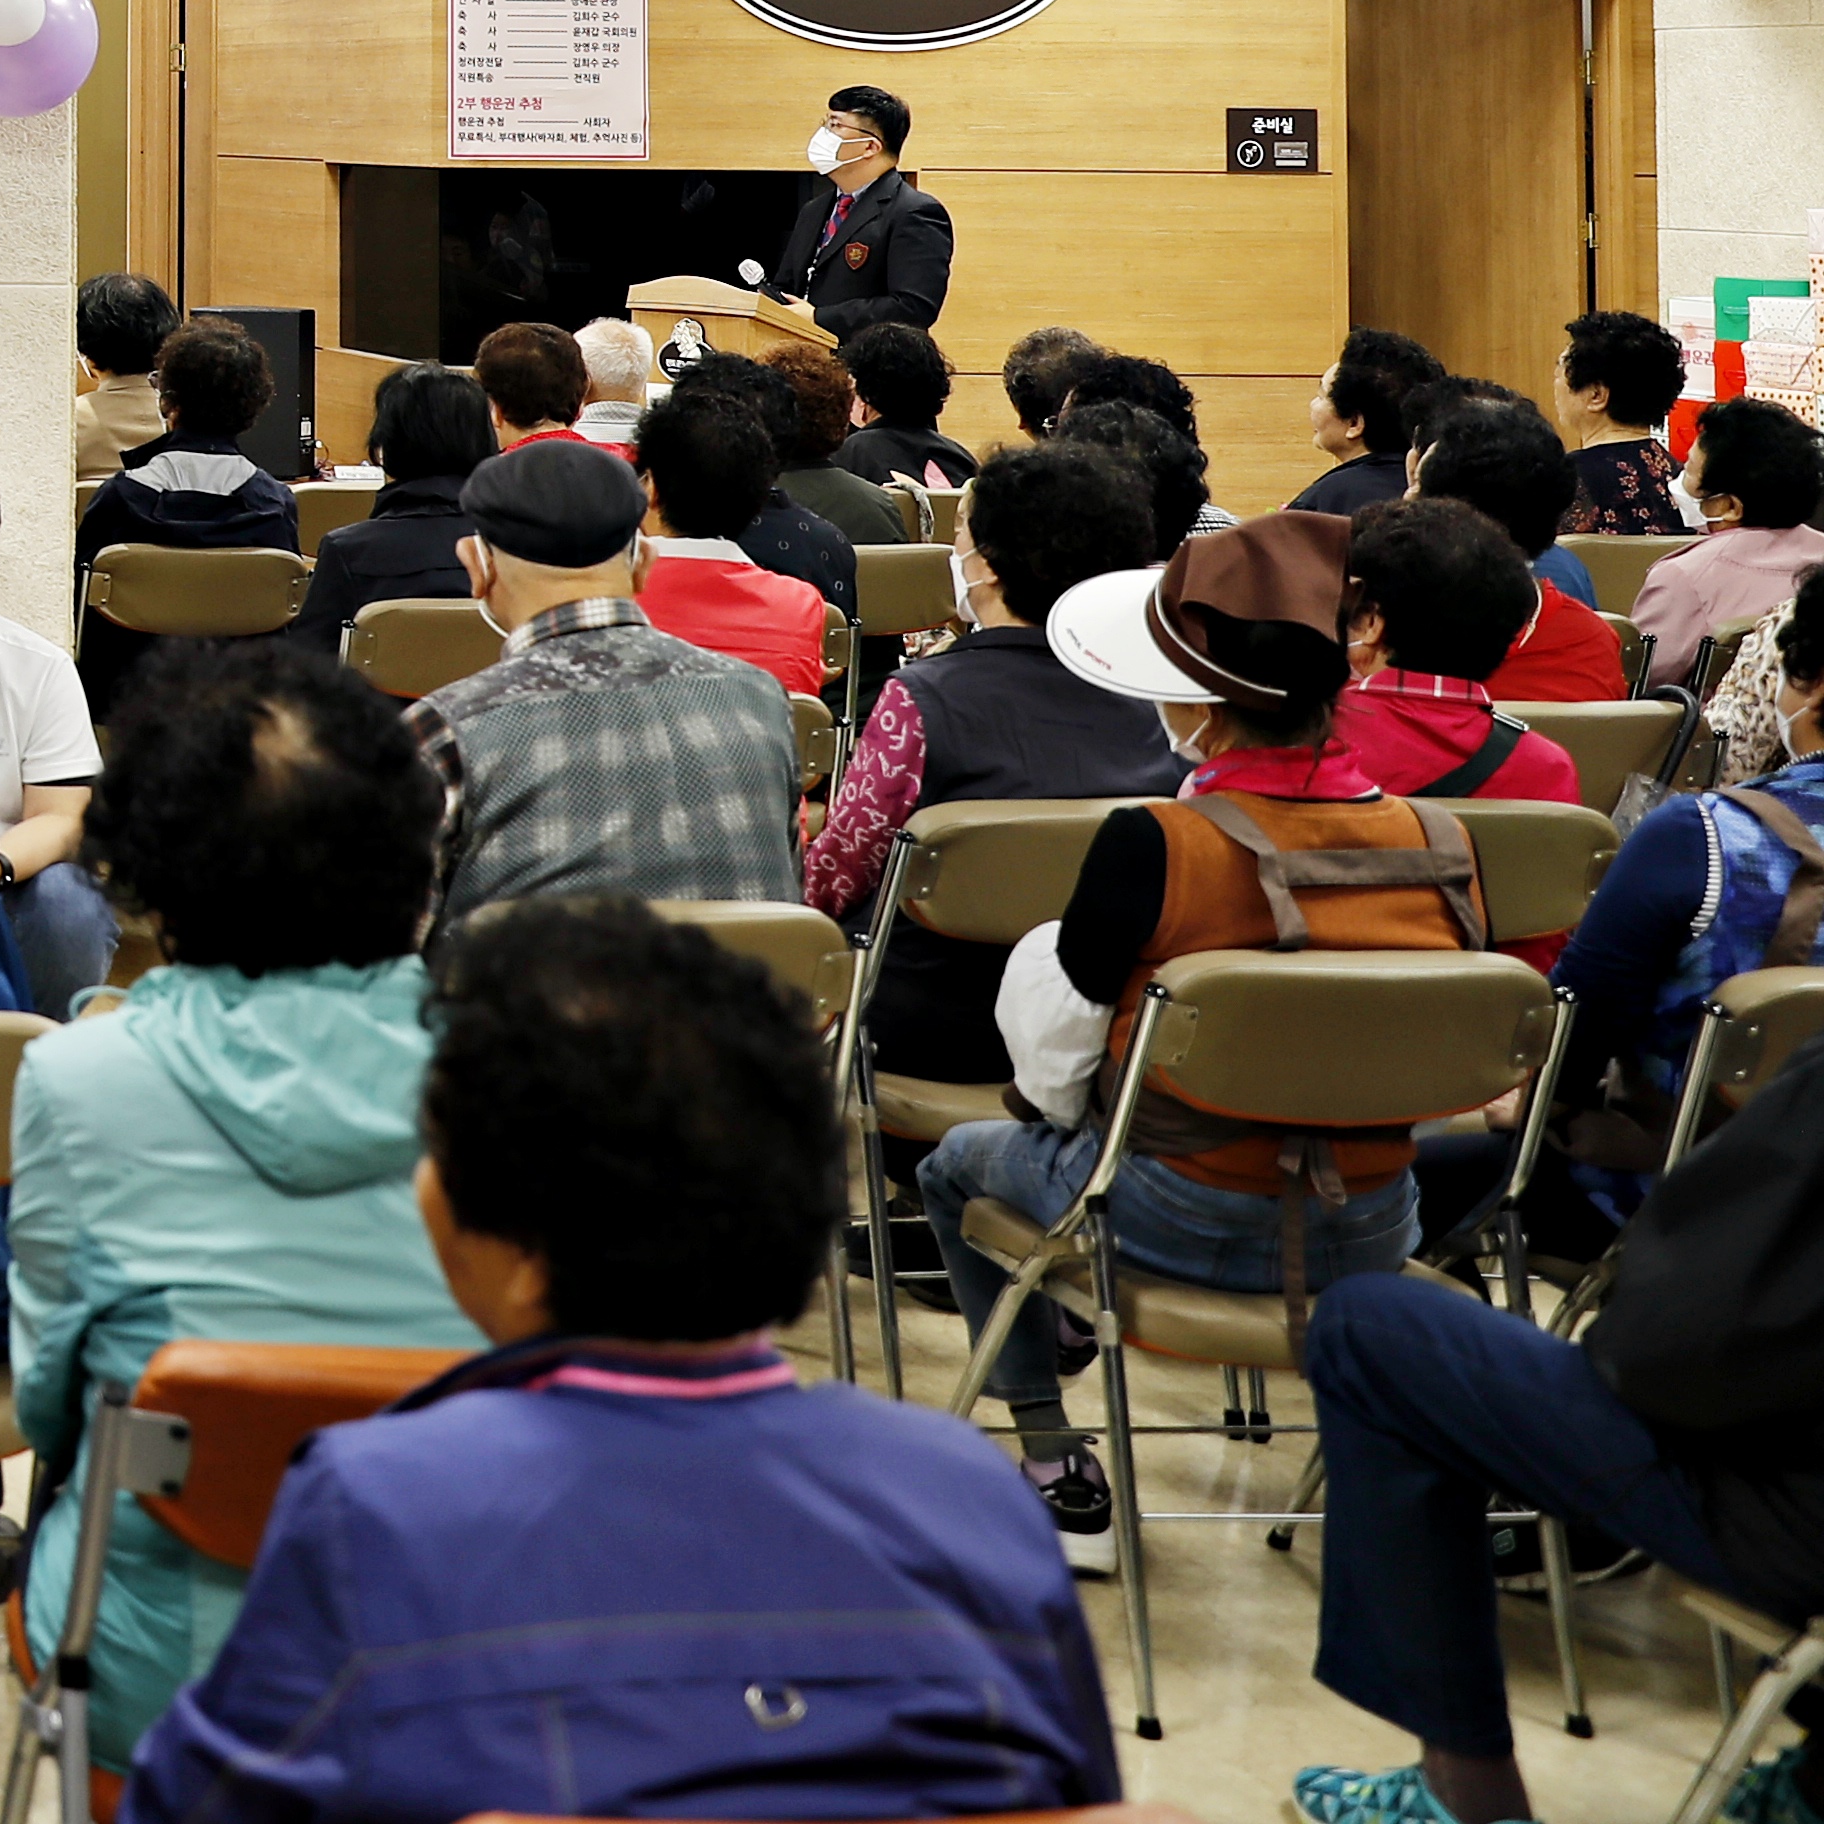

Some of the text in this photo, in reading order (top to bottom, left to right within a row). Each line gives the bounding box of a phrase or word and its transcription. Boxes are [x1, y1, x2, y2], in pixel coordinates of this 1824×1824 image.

[457, 97, 543, 111] 2부 행운권 추첨
[1252, 117, 1293, 134] 준비실
